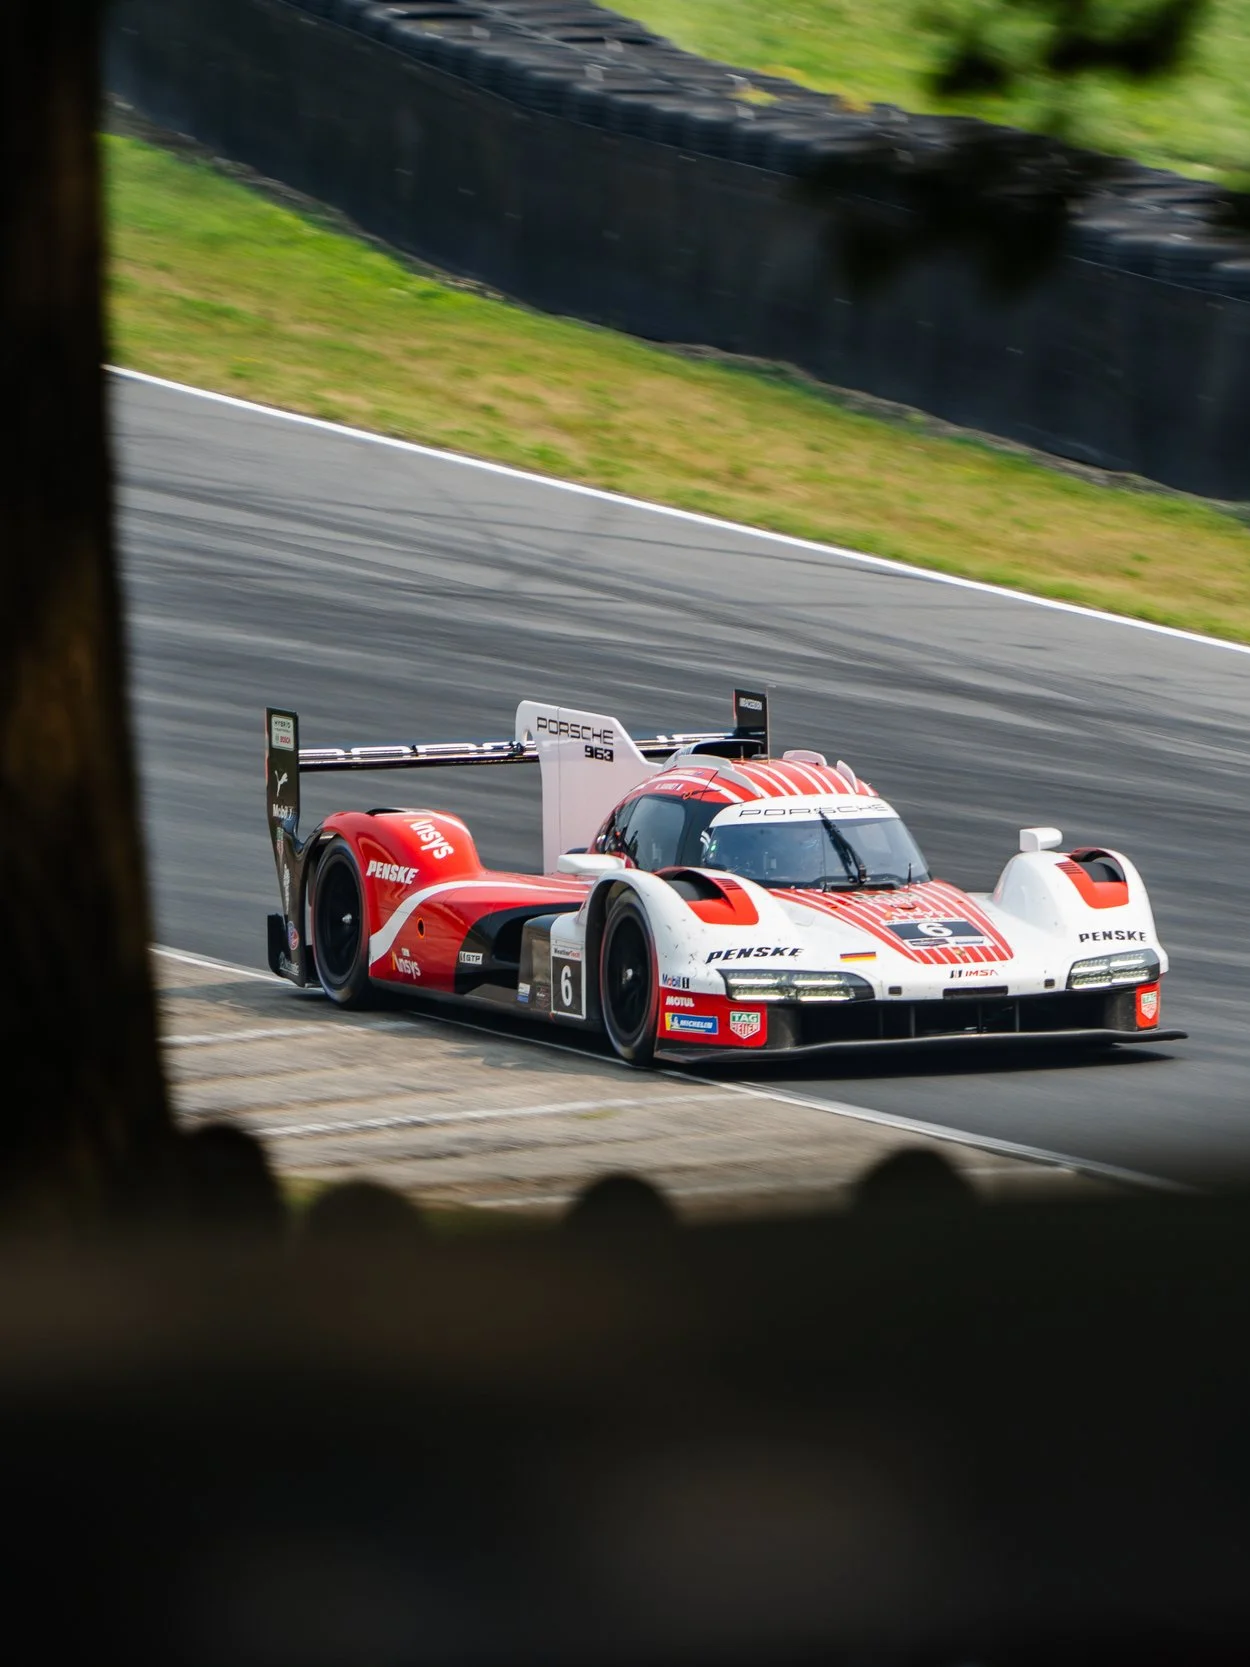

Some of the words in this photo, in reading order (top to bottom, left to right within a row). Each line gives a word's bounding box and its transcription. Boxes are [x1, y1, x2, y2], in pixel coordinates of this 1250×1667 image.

[536, 716, 614, 746] PORSCHE
[584, 744, 614, 762] 963
[739, 803, 889, 817] PORSCHE
[366, 859, 419, 885] PENSKE
[916, 922, 953, 937] 6
[1078, 930, 1147, 943] PENSKE
[465, 953, 481, 963] GTP
[705, 947, 804, 964] PENSKE
[965, 969, 998, 977] IMSA
[561, 965, 572, 1006] 6
[662, 973, 681, 988] Mobil
[682, 976, 690, 989] 1
[665, 996, 695, 1007] MOTUL
[680, 1019, 713, 1029] MICHELIN
[732, 1012, 759, 1022] TAG
[730, 1022, 760, 1036] HEUER
